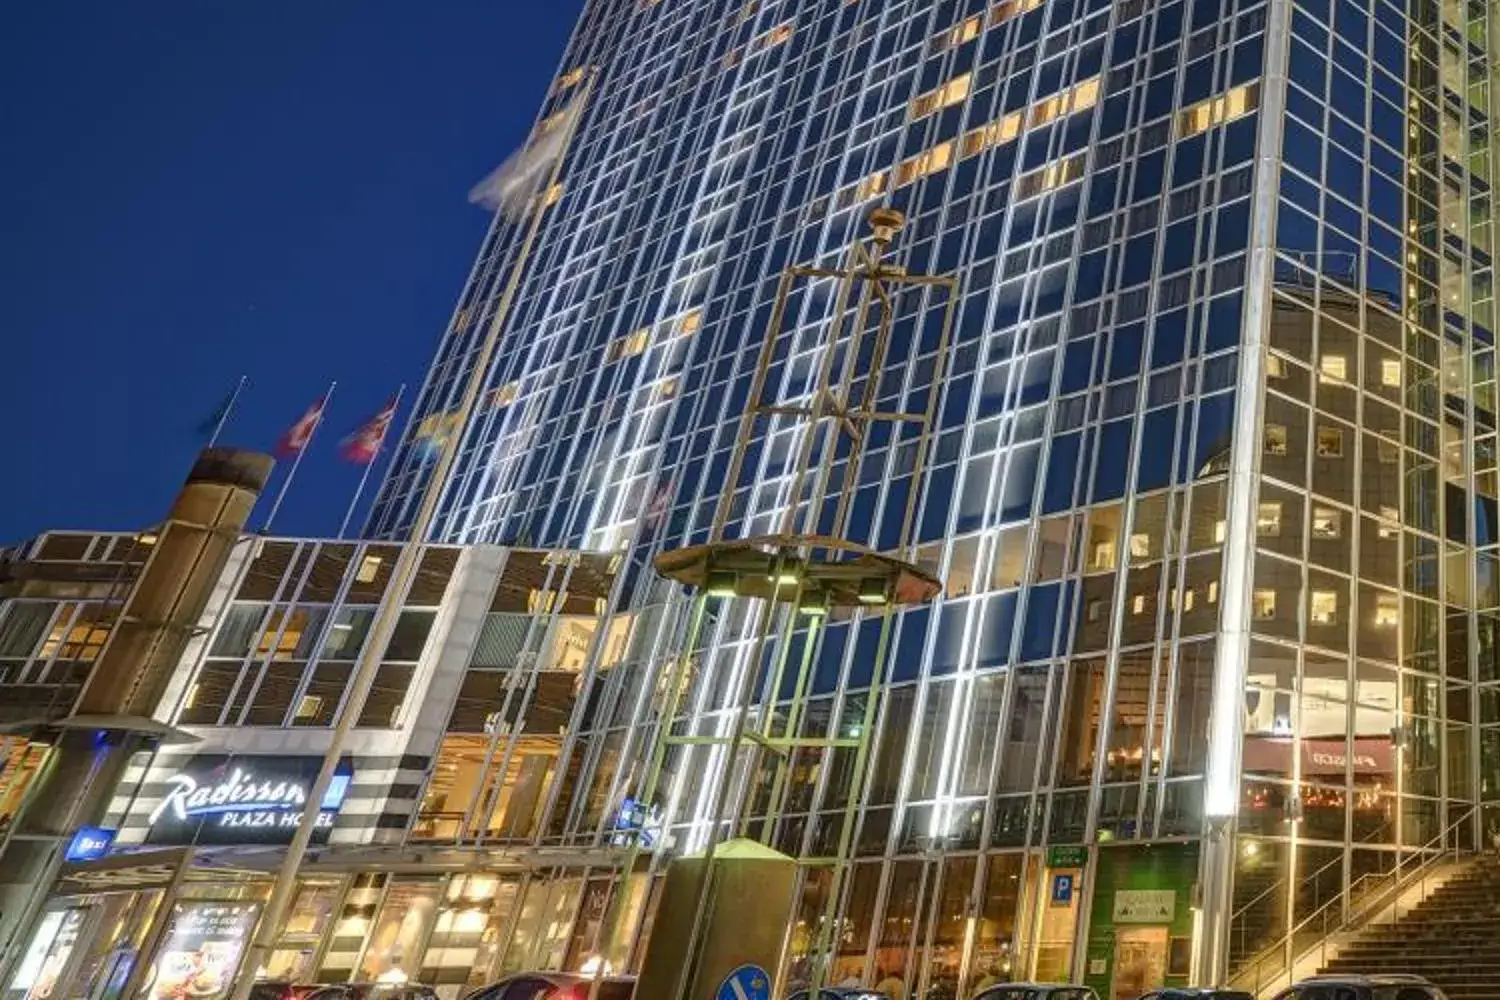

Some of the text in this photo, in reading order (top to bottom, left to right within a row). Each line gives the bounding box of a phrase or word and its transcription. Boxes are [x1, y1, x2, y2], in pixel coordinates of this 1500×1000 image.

[151, 768, 305, 825] Radisson
[221, 811, 333, 827] PLAZA HOEL
[1057, 877, 1070, 898] P
